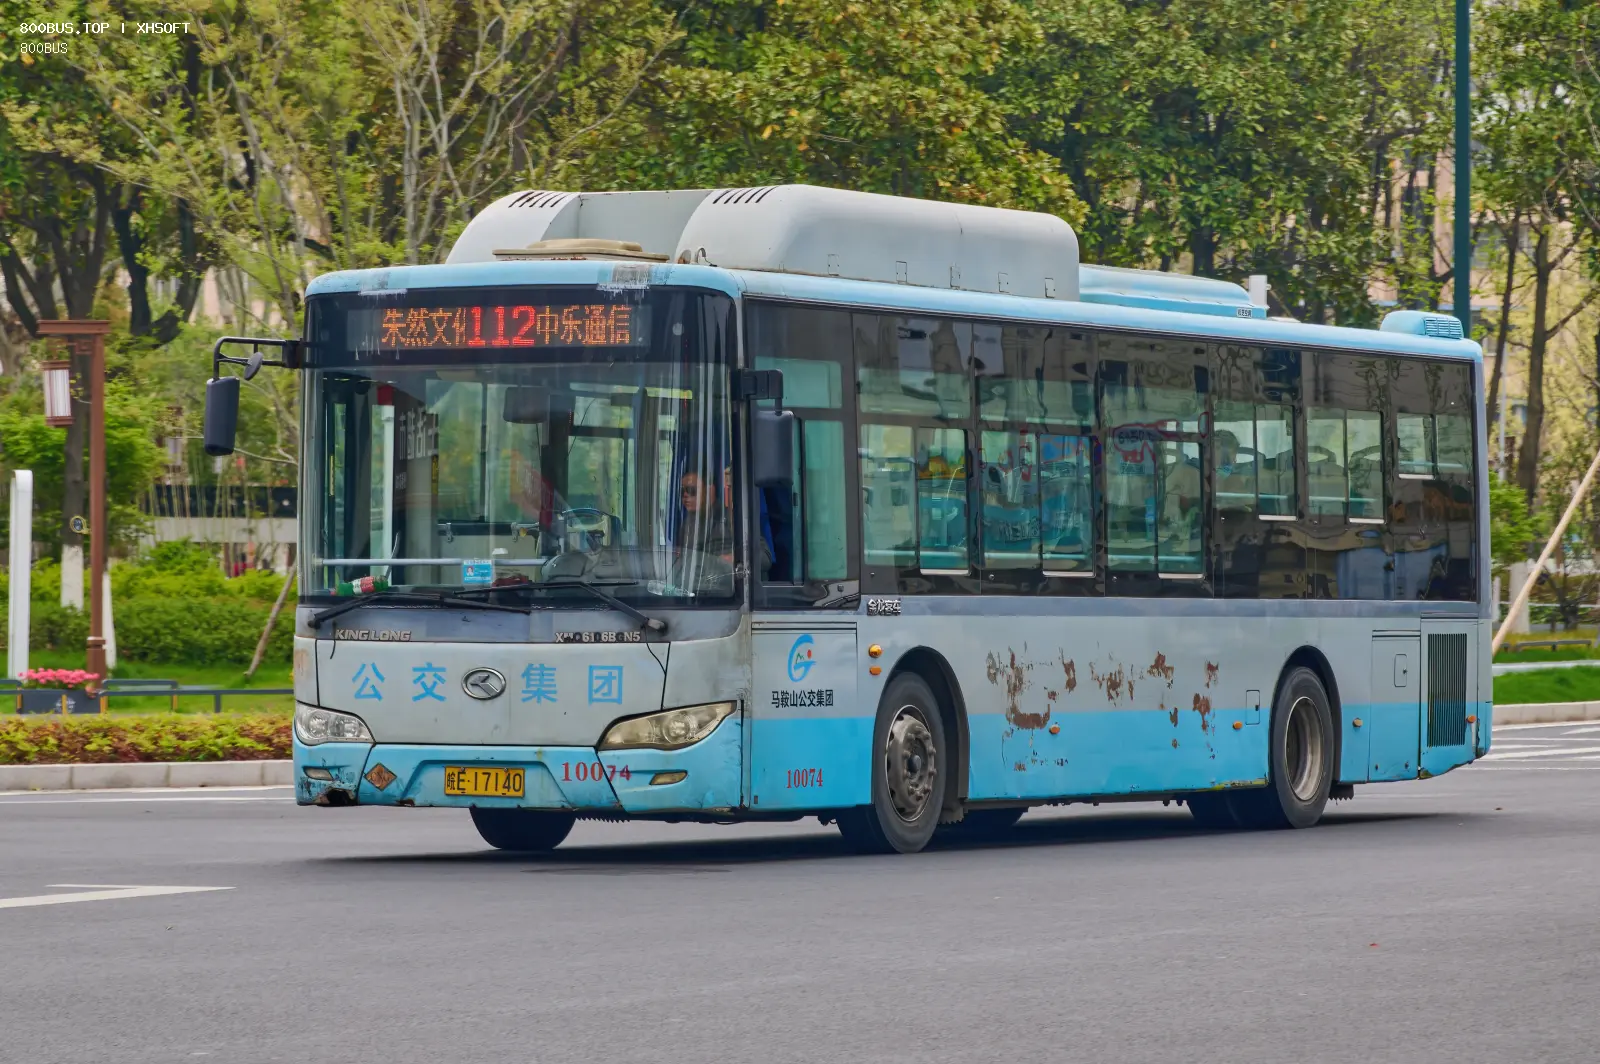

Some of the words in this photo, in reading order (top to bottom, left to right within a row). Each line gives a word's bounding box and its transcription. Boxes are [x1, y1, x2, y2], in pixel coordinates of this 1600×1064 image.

[469, 305, 536, 346] 112
[536, 304, 633, 345] 中乐通信
[771, 689, 834, 708] 马鞍山公交集团
[561, 761, 632, 782] 10074
[786, 768, 823, 789] 10074
